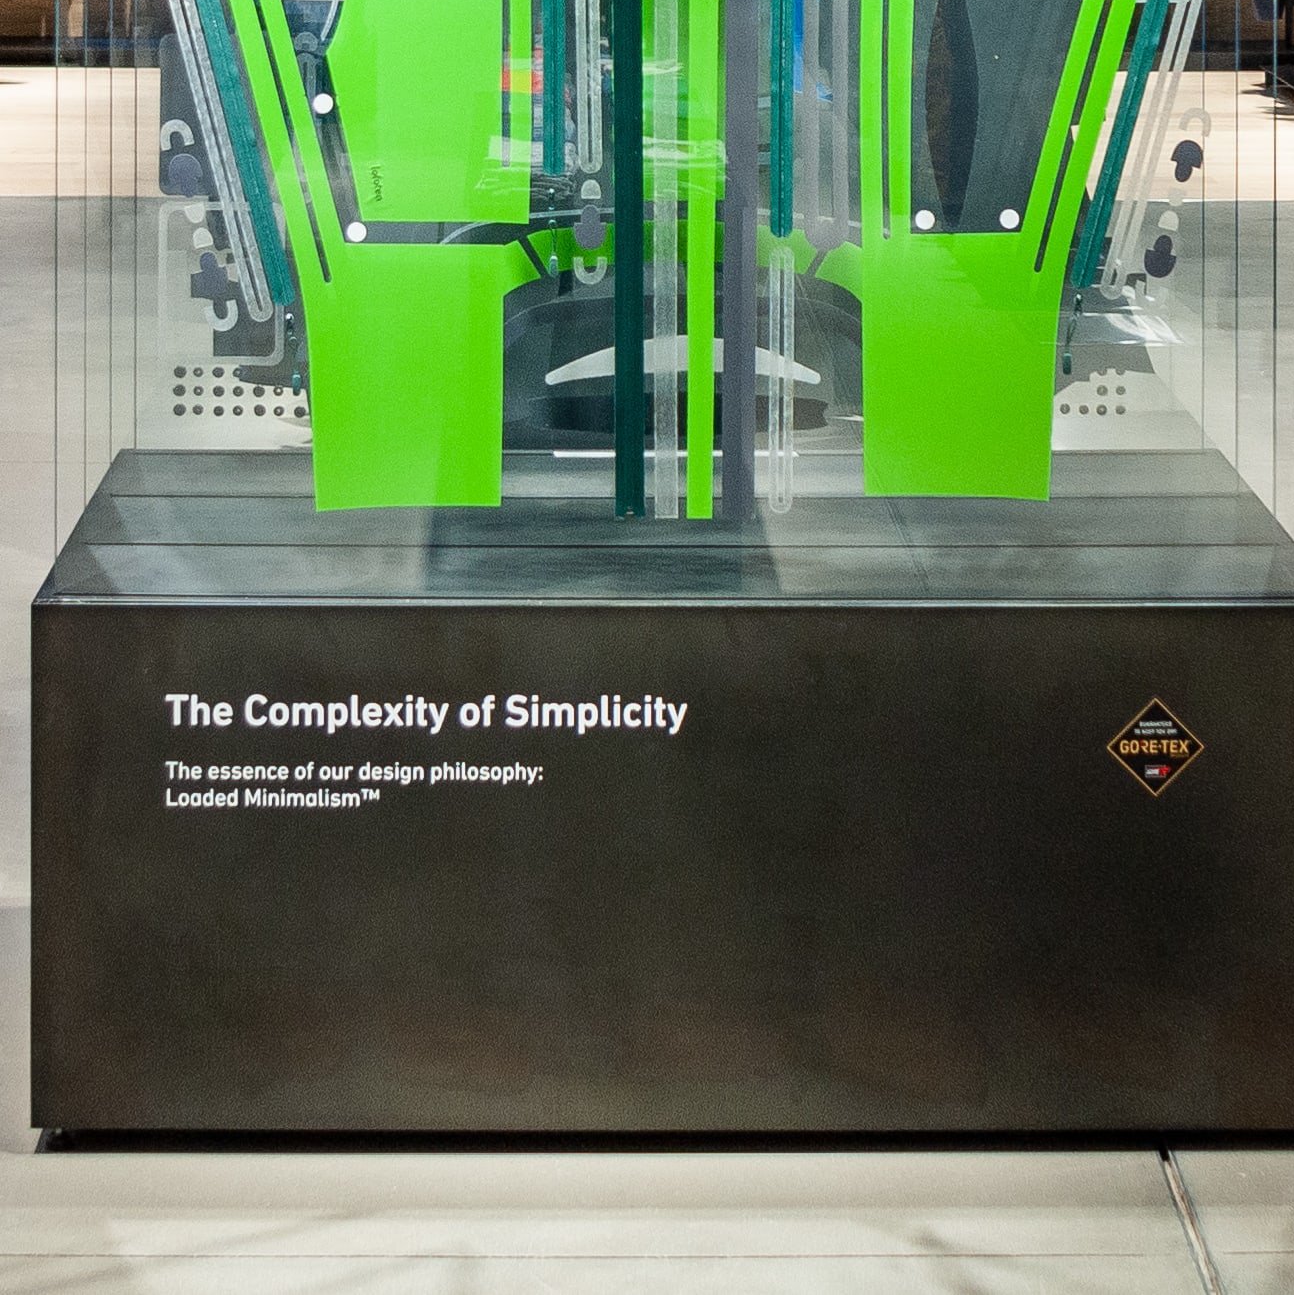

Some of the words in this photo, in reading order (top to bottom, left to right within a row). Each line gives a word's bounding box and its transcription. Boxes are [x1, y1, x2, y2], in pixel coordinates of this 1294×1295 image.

[164, 693, 234, 727] The
[243, 693, 450, 735] Complexity
[458, 694, 496, 729] of
[504, 693, 688, 736] Simplicity
[1120, 739, 1190, 754] GORE-TEX
[165, 760, 203, 781] The
[207, 764, 289, 781] essence
[294, 760, 315, 781] of
[318, 764, 354, 781] our
[358, 761, 425, 786] design
[429, 761, 544, 786] philosophy:
[165, 787, 239, 808] Loaded
[244, 787, 381, 808] Minimalism™
